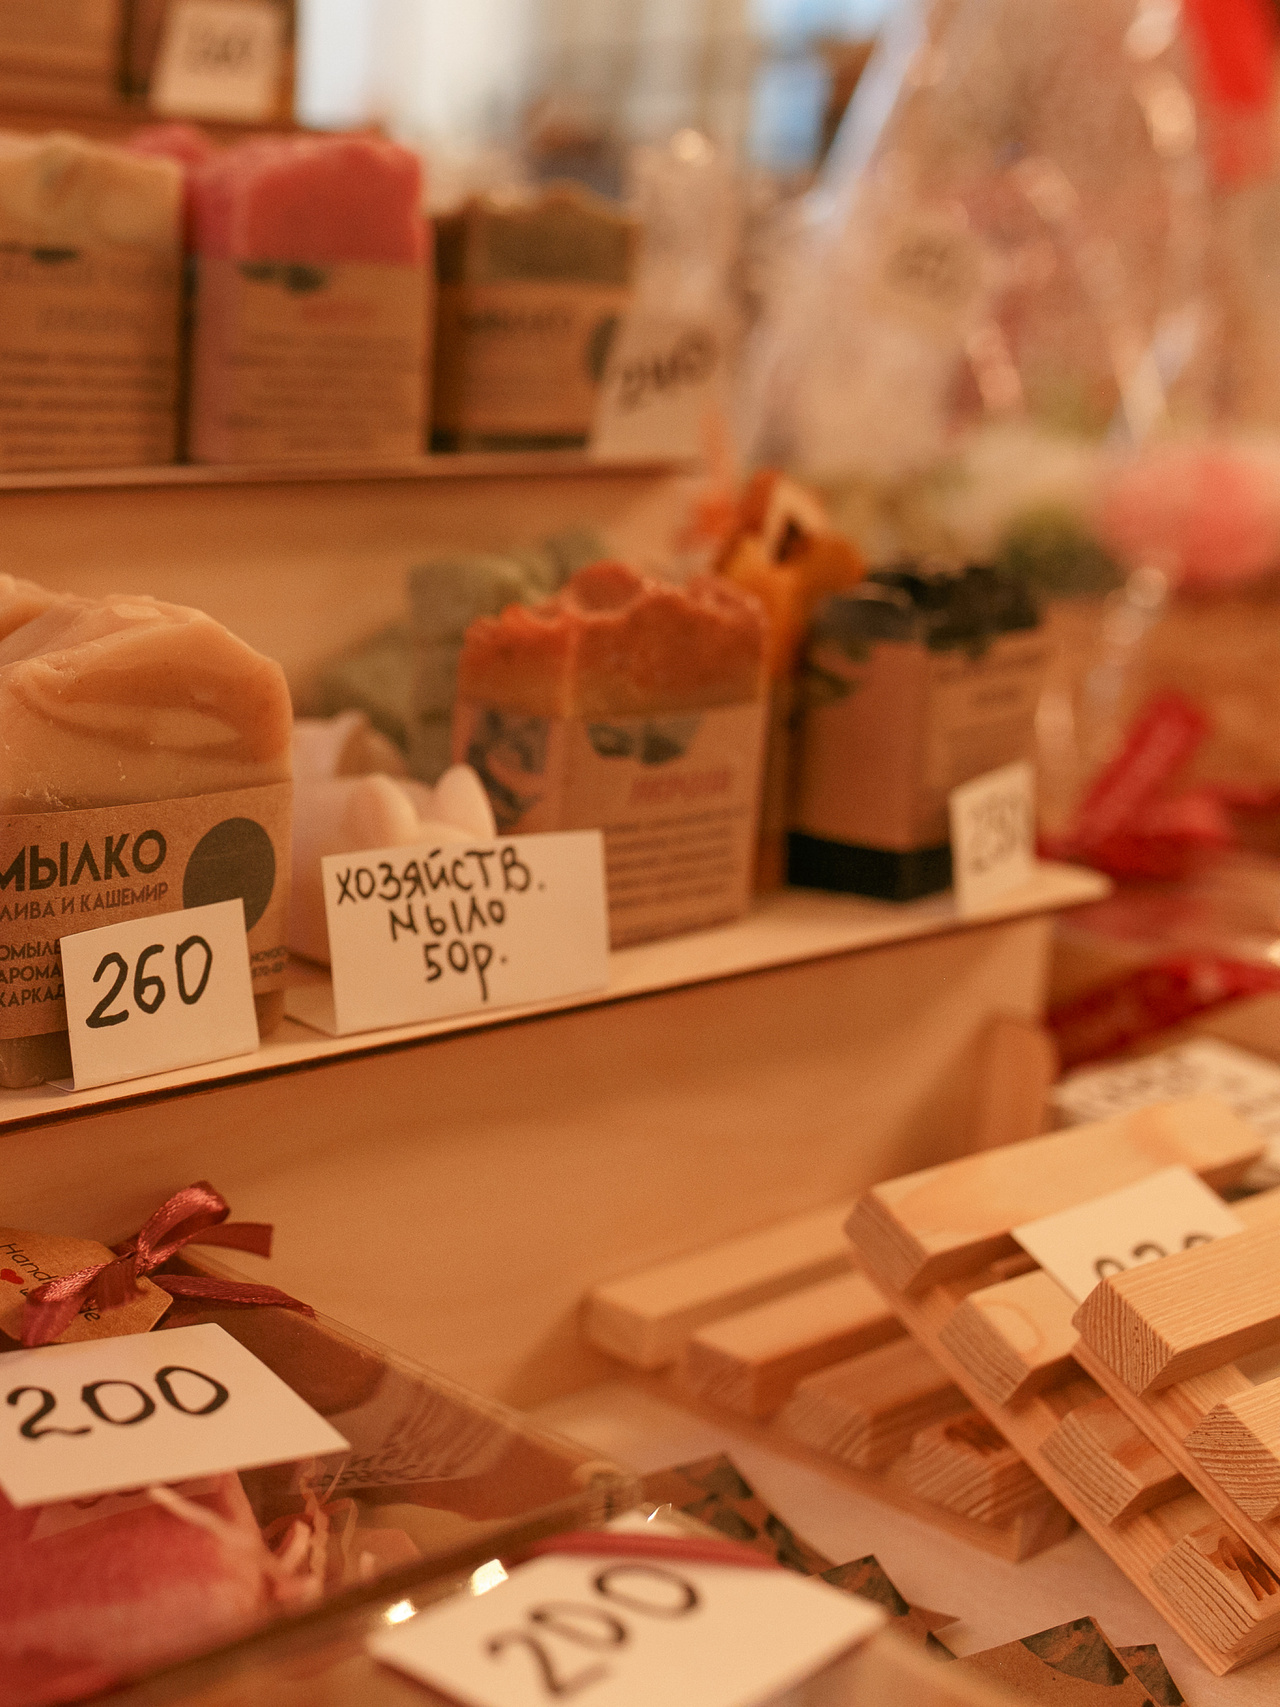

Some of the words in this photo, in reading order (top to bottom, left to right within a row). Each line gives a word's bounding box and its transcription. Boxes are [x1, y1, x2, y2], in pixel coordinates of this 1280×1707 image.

[61, 896, 76, 916] И
[79, 882, 170, 914] КАШЕМИР
[85, 934, 213, 1029] 260
[6, 1365, 229, 1439] 200
[483, 1561, 702, 1701] 200
